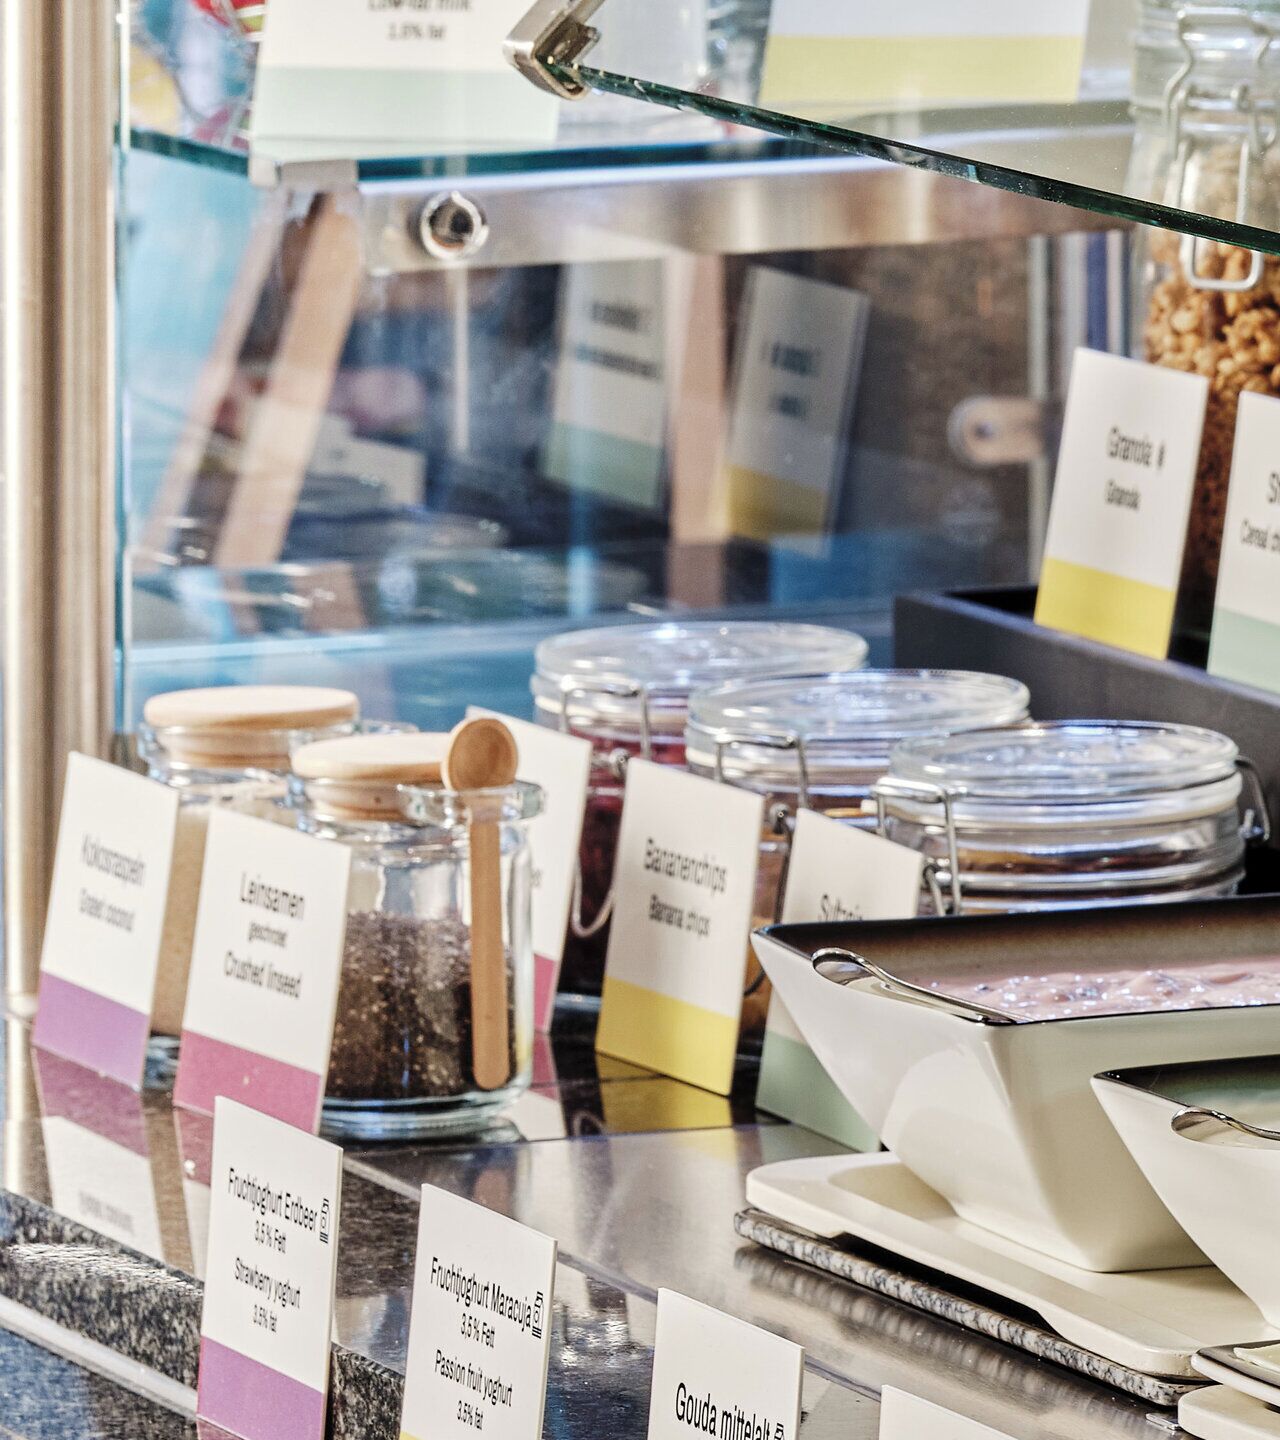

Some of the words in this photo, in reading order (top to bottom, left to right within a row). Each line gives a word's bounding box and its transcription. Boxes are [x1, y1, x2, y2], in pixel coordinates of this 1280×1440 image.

[1106, 425, 1152, 466] Granola
[643, 836, 728, 897] Bananenchips
[240, 870, 306, 920] Leinsamen
[647, 893, 684, 928] Banana
[685, 906, 711, 937] chips
[224, 949, 265, 987] Crushed
[267, 961, 302, 999] linseed
[228, 1167, 283, 1217] Fruchtjoghurt
[284, 1191, 317, 1232] Erdbeer
[273, 1228, 287, 1254] Fett
[234, 1257, 273, 1300] Strawberry
[273, 1277, 301, 1309] yoghurt
[430, 1256, 491, 1308] Fruchtjoghurt
[490, 1283, 532, 1332] Maracuja
[269, 1308, 278, 1333] fat
[481, 1321, 496, 1349] Fett
[434, 1349, 466, 1385] Passion
[466, 1362, 483, 1393] fruit
[482, 1374, 513, 1407] yoghurt
[456, 1400, 474, 1426] 3.5%
[474, 1406, 484, 1431] fat
[675, 1382, 717, 1436] Gouda
